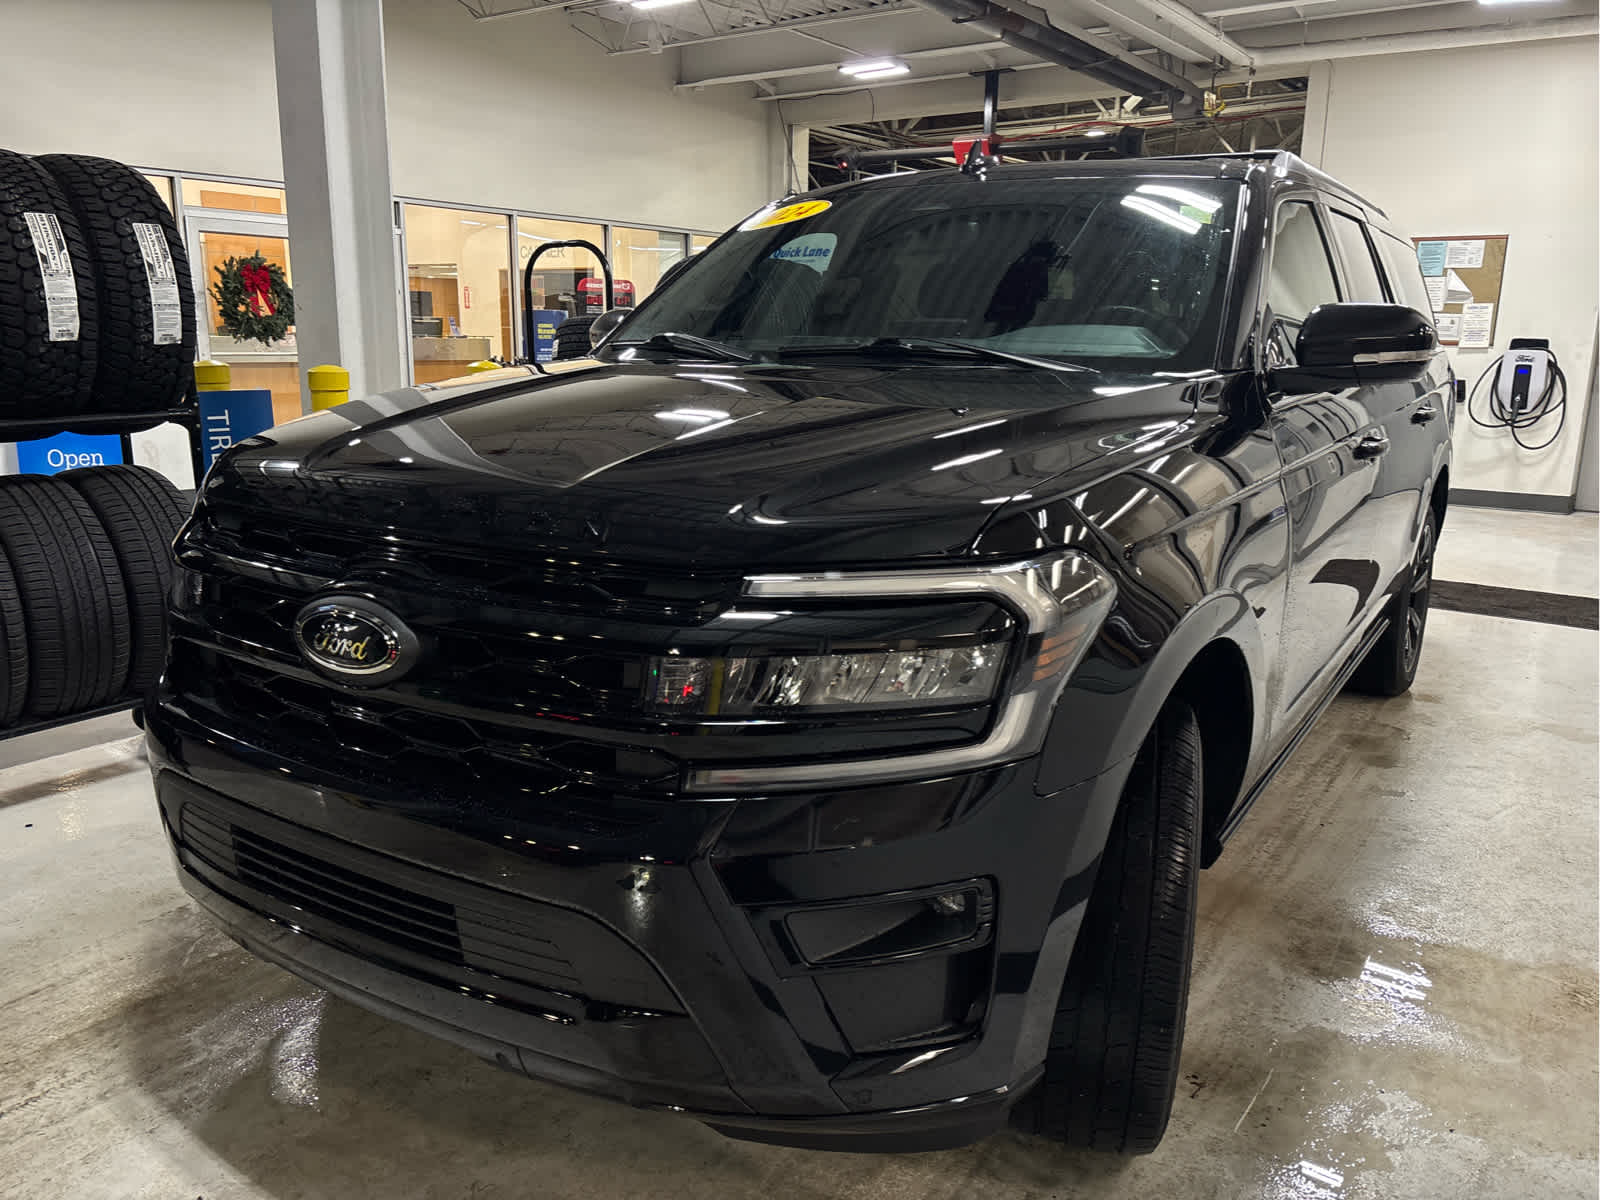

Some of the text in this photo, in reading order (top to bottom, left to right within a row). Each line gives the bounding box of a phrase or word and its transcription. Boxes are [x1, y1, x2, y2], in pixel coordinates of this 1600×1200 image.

[520, 246, 566, 259] CAIER
[773, 246, 831, 258] Quick Lane
[47, 449, 105, 469] Open
[314, 622, 371, 660] Ford
